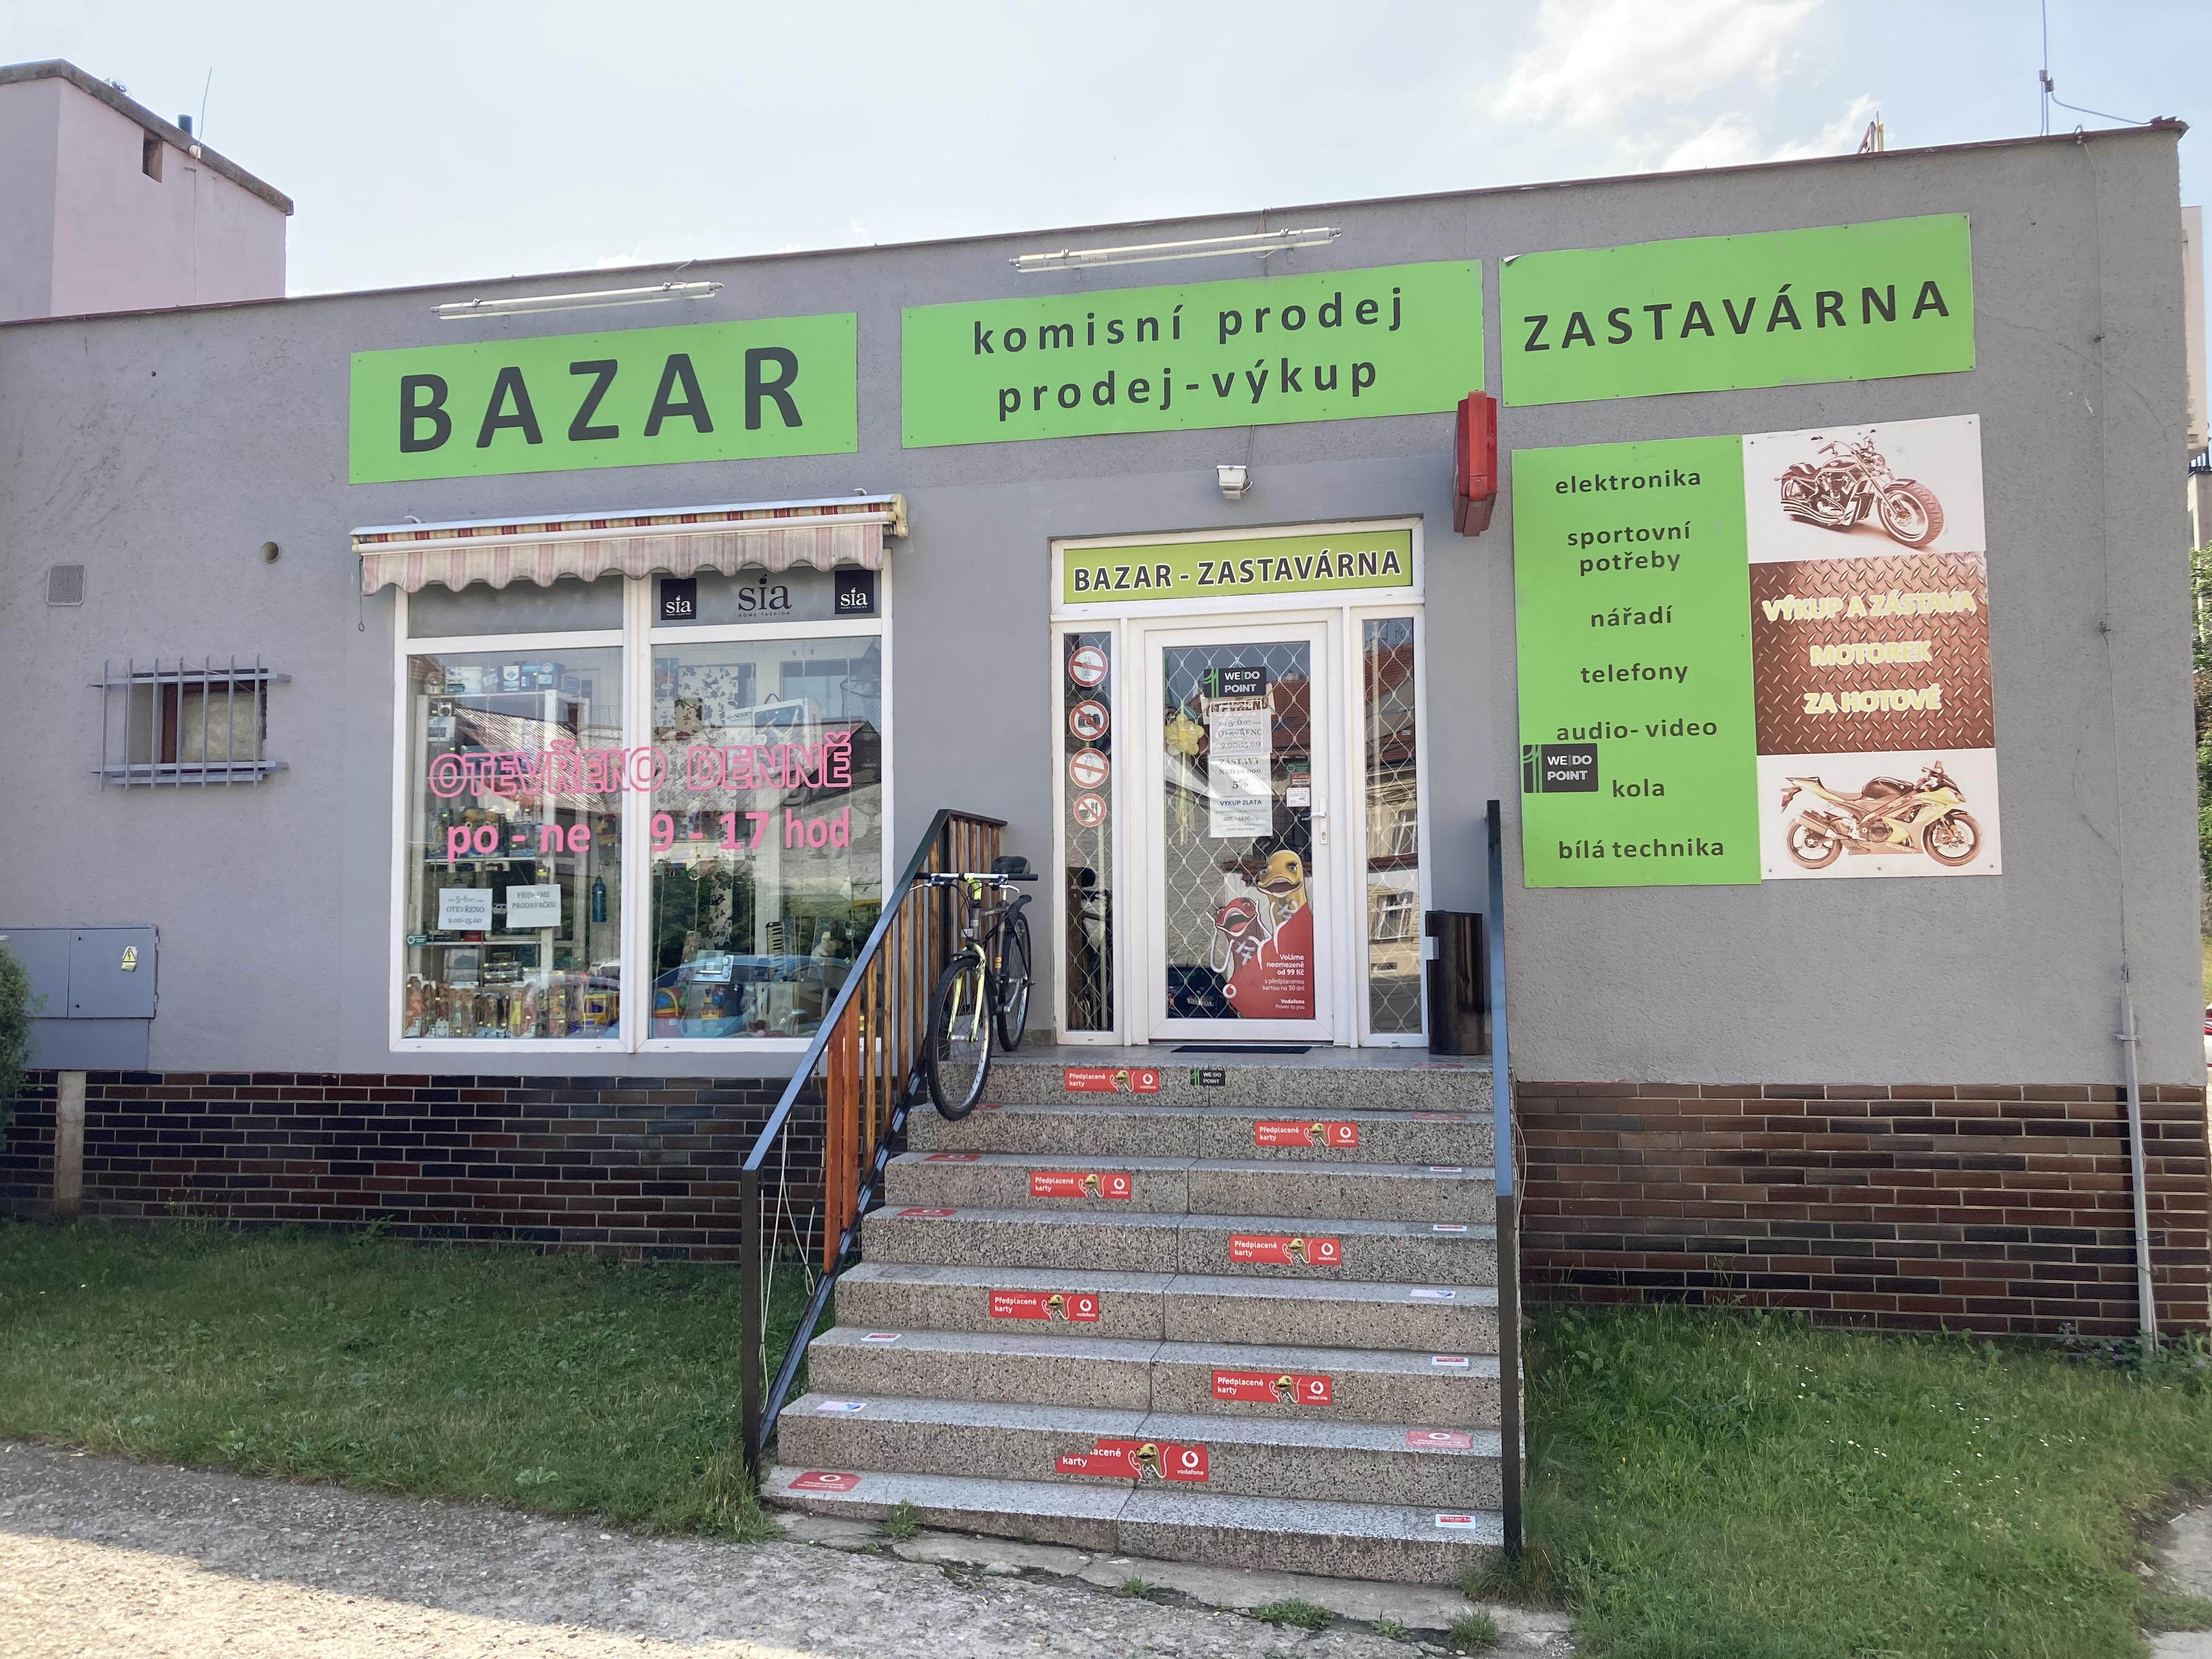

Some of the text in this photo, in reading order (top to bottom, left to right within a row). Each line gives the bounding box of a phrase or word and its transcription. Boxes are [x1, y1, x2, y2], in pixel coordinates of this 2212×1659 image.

[974, 288, 1402, 355] komisní prodej
[1524, 281, 1949, 352] ZASTAVÁRNA
[400, 347, 803, 453] BAZAR
[1555, 469, 1701, 494] elektronika
[1567, 521, 1691, 549] sportovní
[1073, 564, 1173, 593] BAZAR
[1196, 549, 1402, 587] ZASTAVÁRNA
[1580, 550, 1681, 576] potřeby
[738, 574, 792, 611] sia
[841, 587, 868, 606] sia
[666, 595, 692, 613] sia
[1762, 589, 1978, 622] VÝKUP A ZÁSTAVA
[1591, 606, 1673, 627] nářadí
[1809, 640, 1932, 667] MOTOREK
[1580, 662, 1688, 684] telefony
[1224, 684, 1256, 693] POINT
[1804, 682, 1942, 714] ZA HOTOVÉ
[429, 731, 852, 798] OTEVŘENO DENNĚ
[1547, 770, 1588, 781] POINT
[1613, 779, 1666, 797] kola
[447, 825, 498, 862] po
[540, 823, 591, 853] ne
[650, 813, 675, 852] 9
[719, 811, 770, 850] 17
[785, 806, 849, 849] hod
[1559, 838, 1725, 859] bílá technika
[1259, 1126, 1300, 1134] Předplacené
[1234, 1240, 1277, 1249] Předplacené
[1234, 1249, 1253, 1257] karty
[995, 1297, 1037, 1305] Předplacené
[995, 1305, 1013, 1313] karty
[1217, 1377, 1264, 1386] Předplacené
[1217, 1386, 1237, 1395] karty
[1062, 1456, 1088, 1468] karty
[1089, 1448, 1121, 1457] lacené
